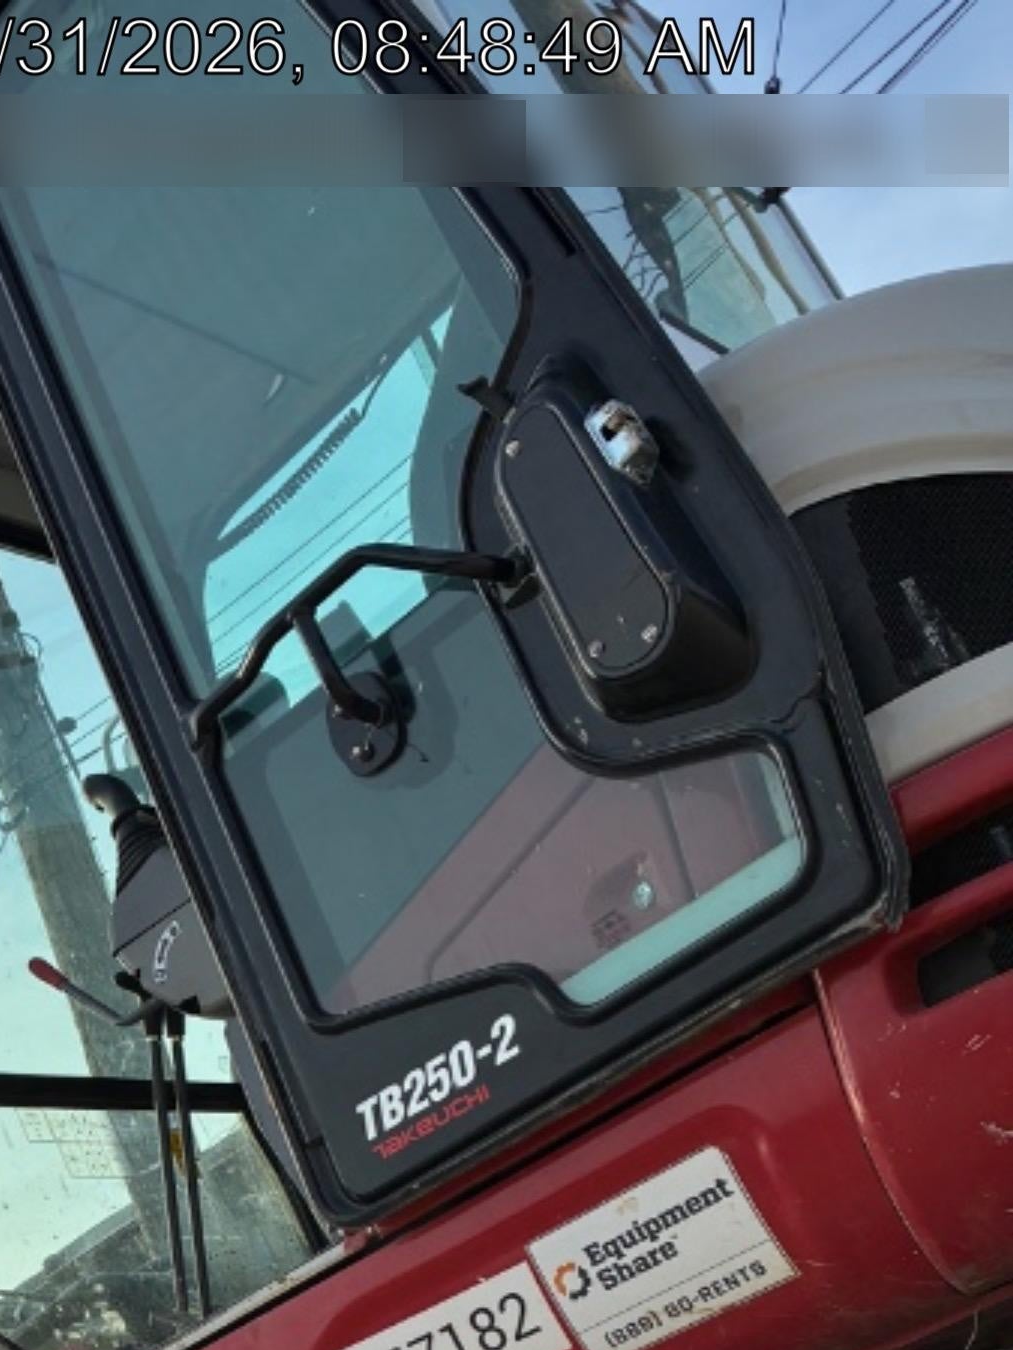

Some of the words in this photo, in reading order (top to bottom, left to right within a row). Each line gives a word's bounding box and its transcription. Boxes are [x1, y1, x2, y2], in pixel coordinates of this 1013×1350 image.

[355, 1014, 521, 1141] TB250-2
[582, 1176, 735, 1268] Equipment
[596, 1239, 679, 1292] Share
